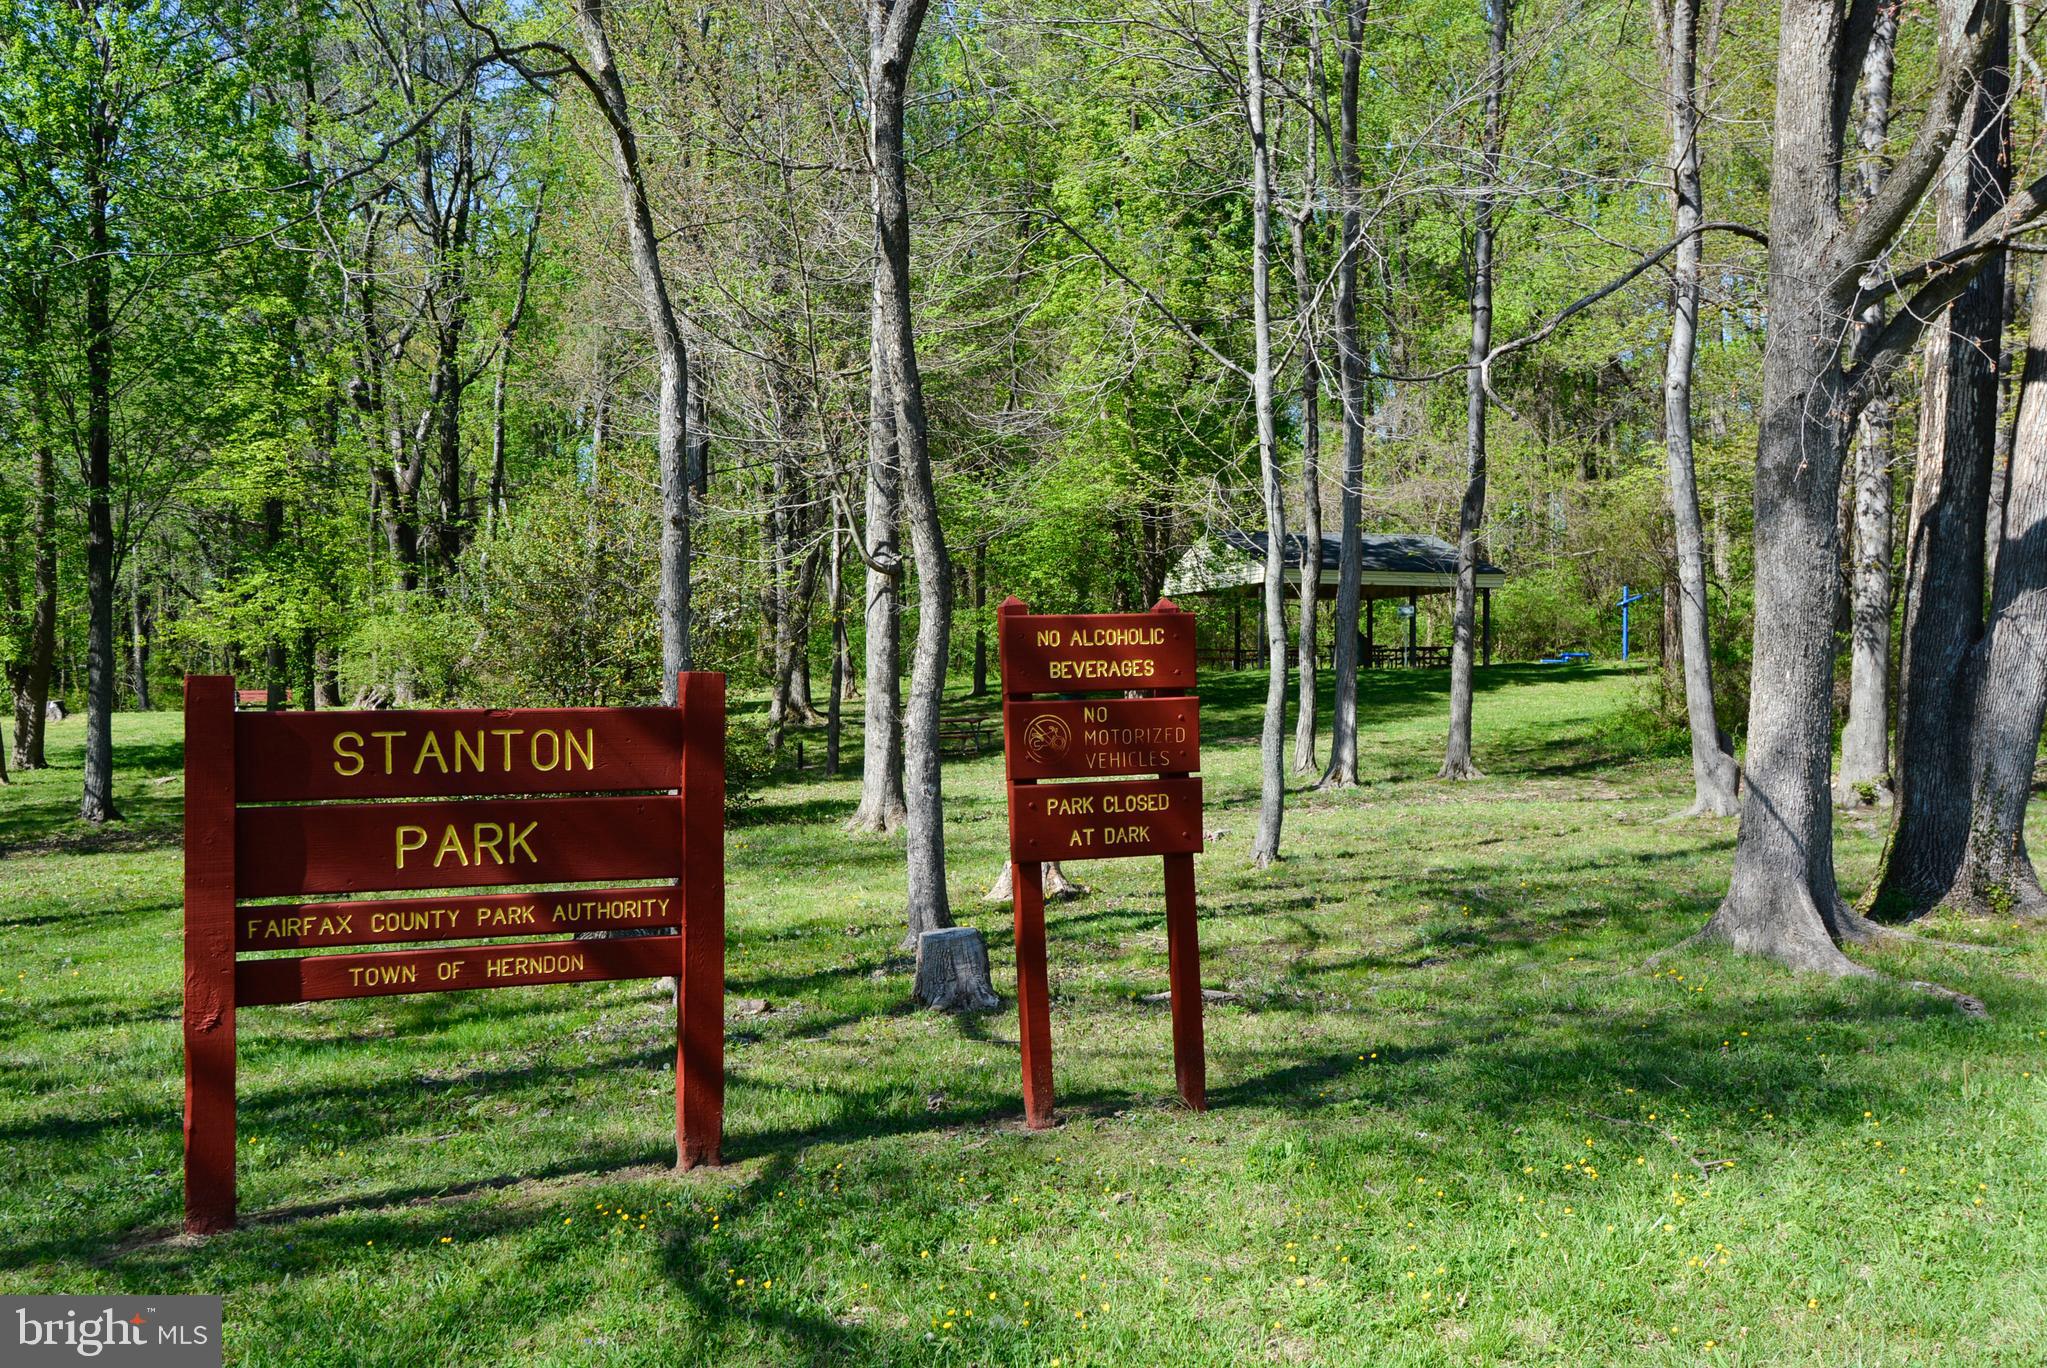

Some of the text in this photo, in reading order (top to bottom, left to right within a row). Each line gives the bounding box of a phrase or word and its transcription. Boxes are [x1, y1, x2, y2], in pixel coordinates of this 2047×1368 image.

[1036, 628, 1165, 647] NO ALCOHOLIC
[1049, 659, 1154, 679] BEVERAGES
[1083, 706, 1108, 724] NO
[1084, 727, 1186, 746] MOTORIZED
[332, 727, 594, 777] STANTON
[1085, 751, 1170, 769] VEHICLES
[1047, 794, 1169, 816] PARK CLOSED
[396, 820, 539, 869] PARK
[1069, 826, 1150, 847] AT DARK
[247, 898, 670, 940] FAIRFAX COUNTY PARK AUTHORITY
[348, 954, 584, 988] TOWN OF HERNDON
